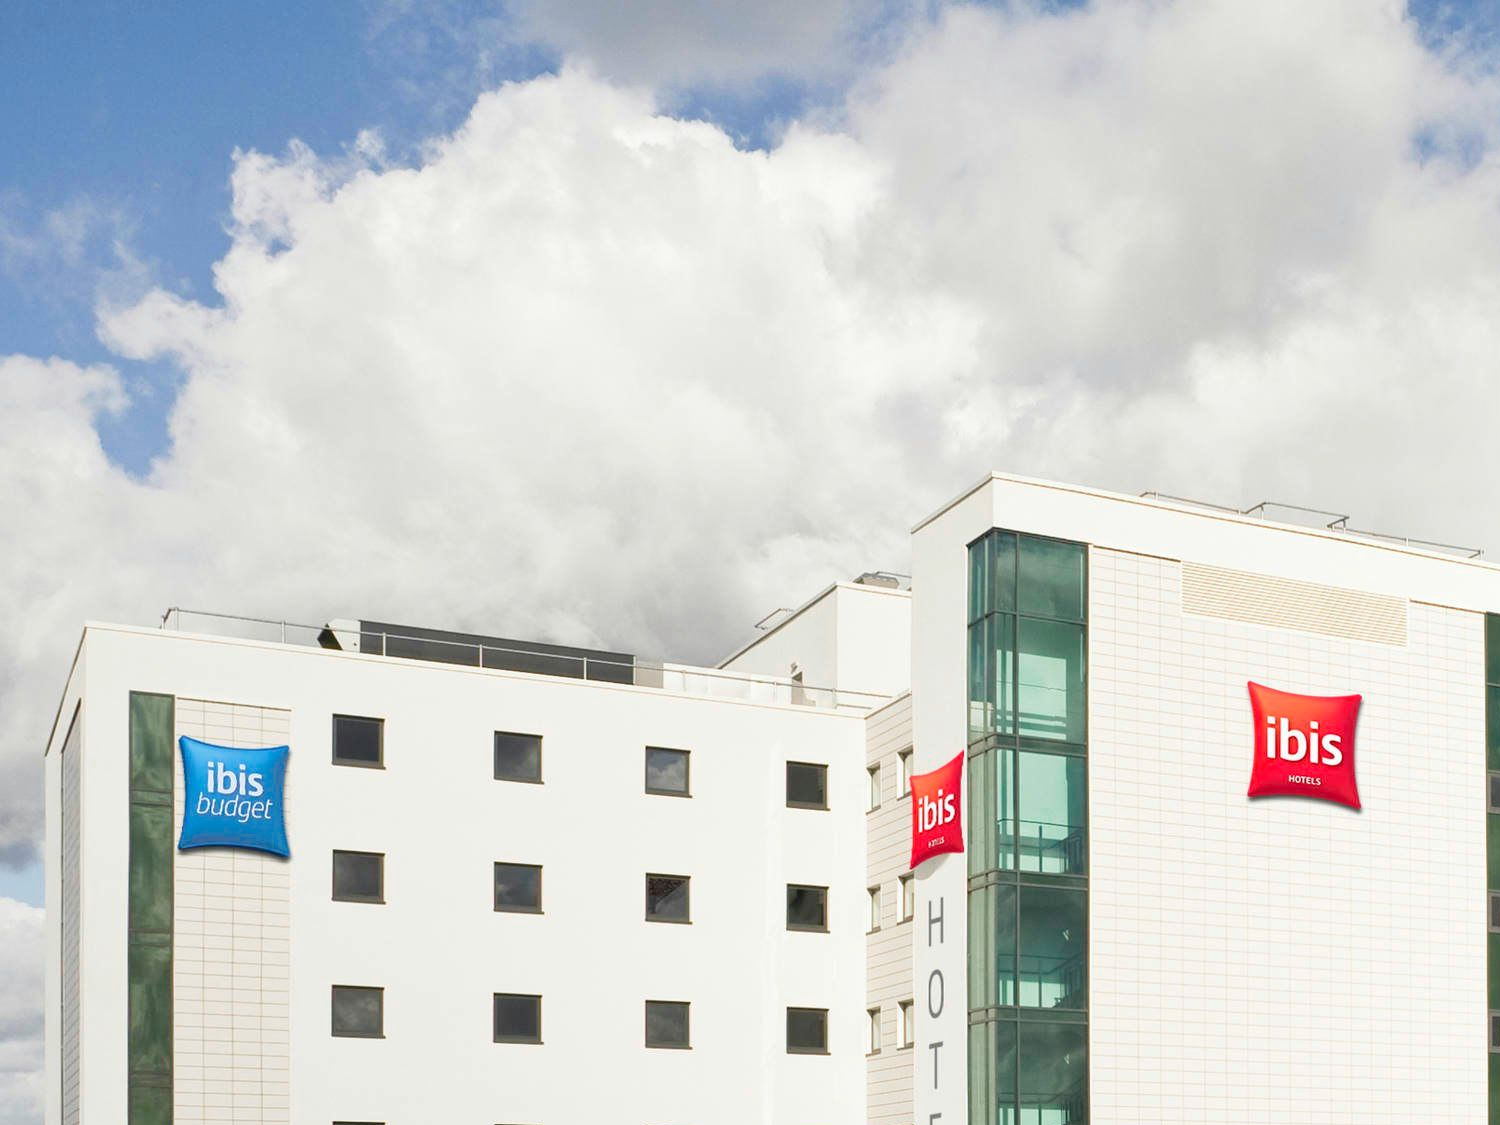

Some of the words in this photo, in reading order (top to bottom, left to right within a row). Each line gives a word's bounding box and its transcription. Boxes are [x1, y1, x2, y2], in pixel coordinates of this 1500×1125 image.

[1266, 715, 1343, 766] ibis
[207, 761, 264, 797] ibis
[1288, 774, 1322, 786] HOTELS
[196, 791, 274, 823] budget
[918, 789, 956, 833] ibis
